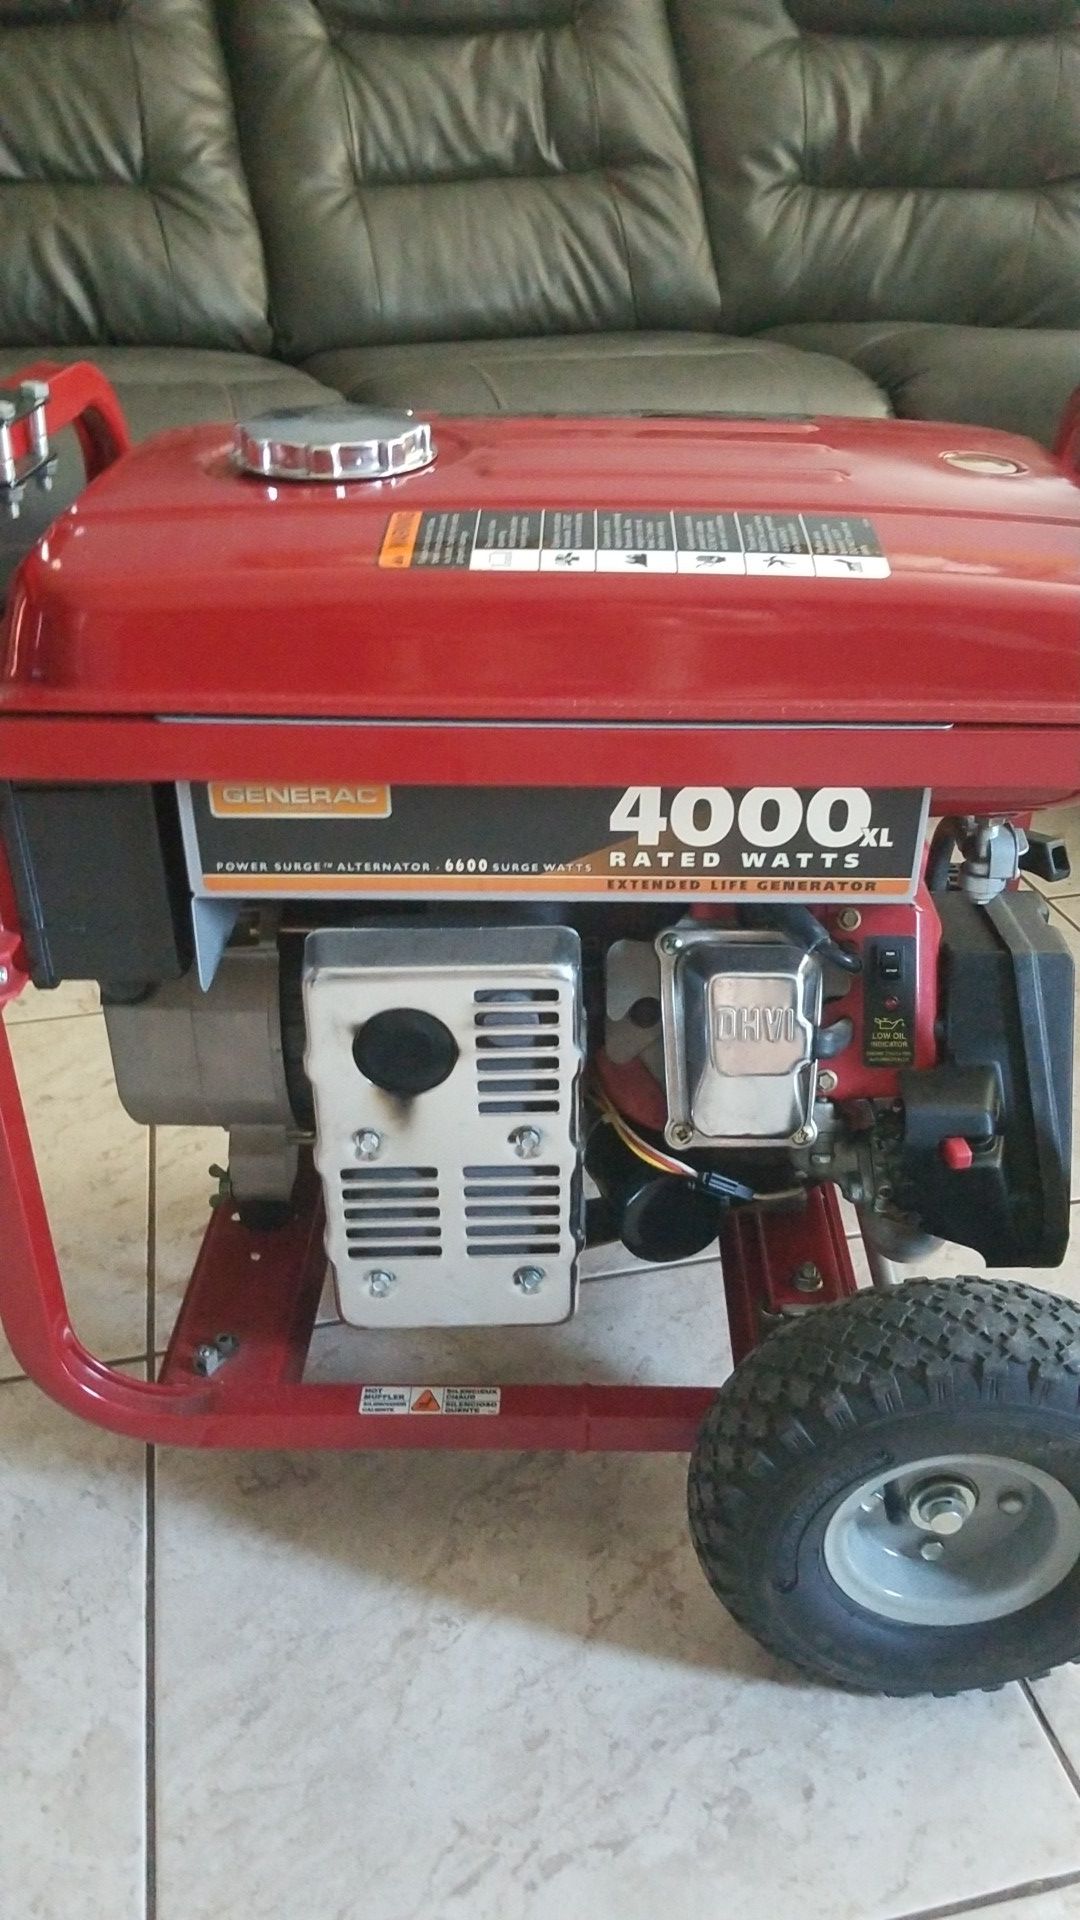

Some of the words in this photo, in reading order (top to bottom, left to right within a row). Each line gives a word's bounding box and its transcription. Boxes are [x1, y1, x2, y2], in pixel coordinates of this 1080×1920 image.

[222, 787, 378, 804] GENERAC
[609, 786, 872, 848] 4000
[859, 827, 894, 847] XL
[216, 861, 268, 872] POWER
[336, 861, 431, 872] ALTERNATOR
[444, 858, 488, 873] 6600
[492, 862, 539, 873] SURGE
[543, 862, 593, 873] WATTS
[609, 851, 721, 868] RATED
[741, 852, 861, 869] WATTS
[606, 879, 701, 891] EXTENDED
[710, 879, 748, 891] LIFE
[756, 880, 877, 892] GENERATOR
[871, 1032, 891, 1040] LOW
[892, 1032, 907, 1040] OIL
[870, 1040, 909, 1048] INDICATOR
